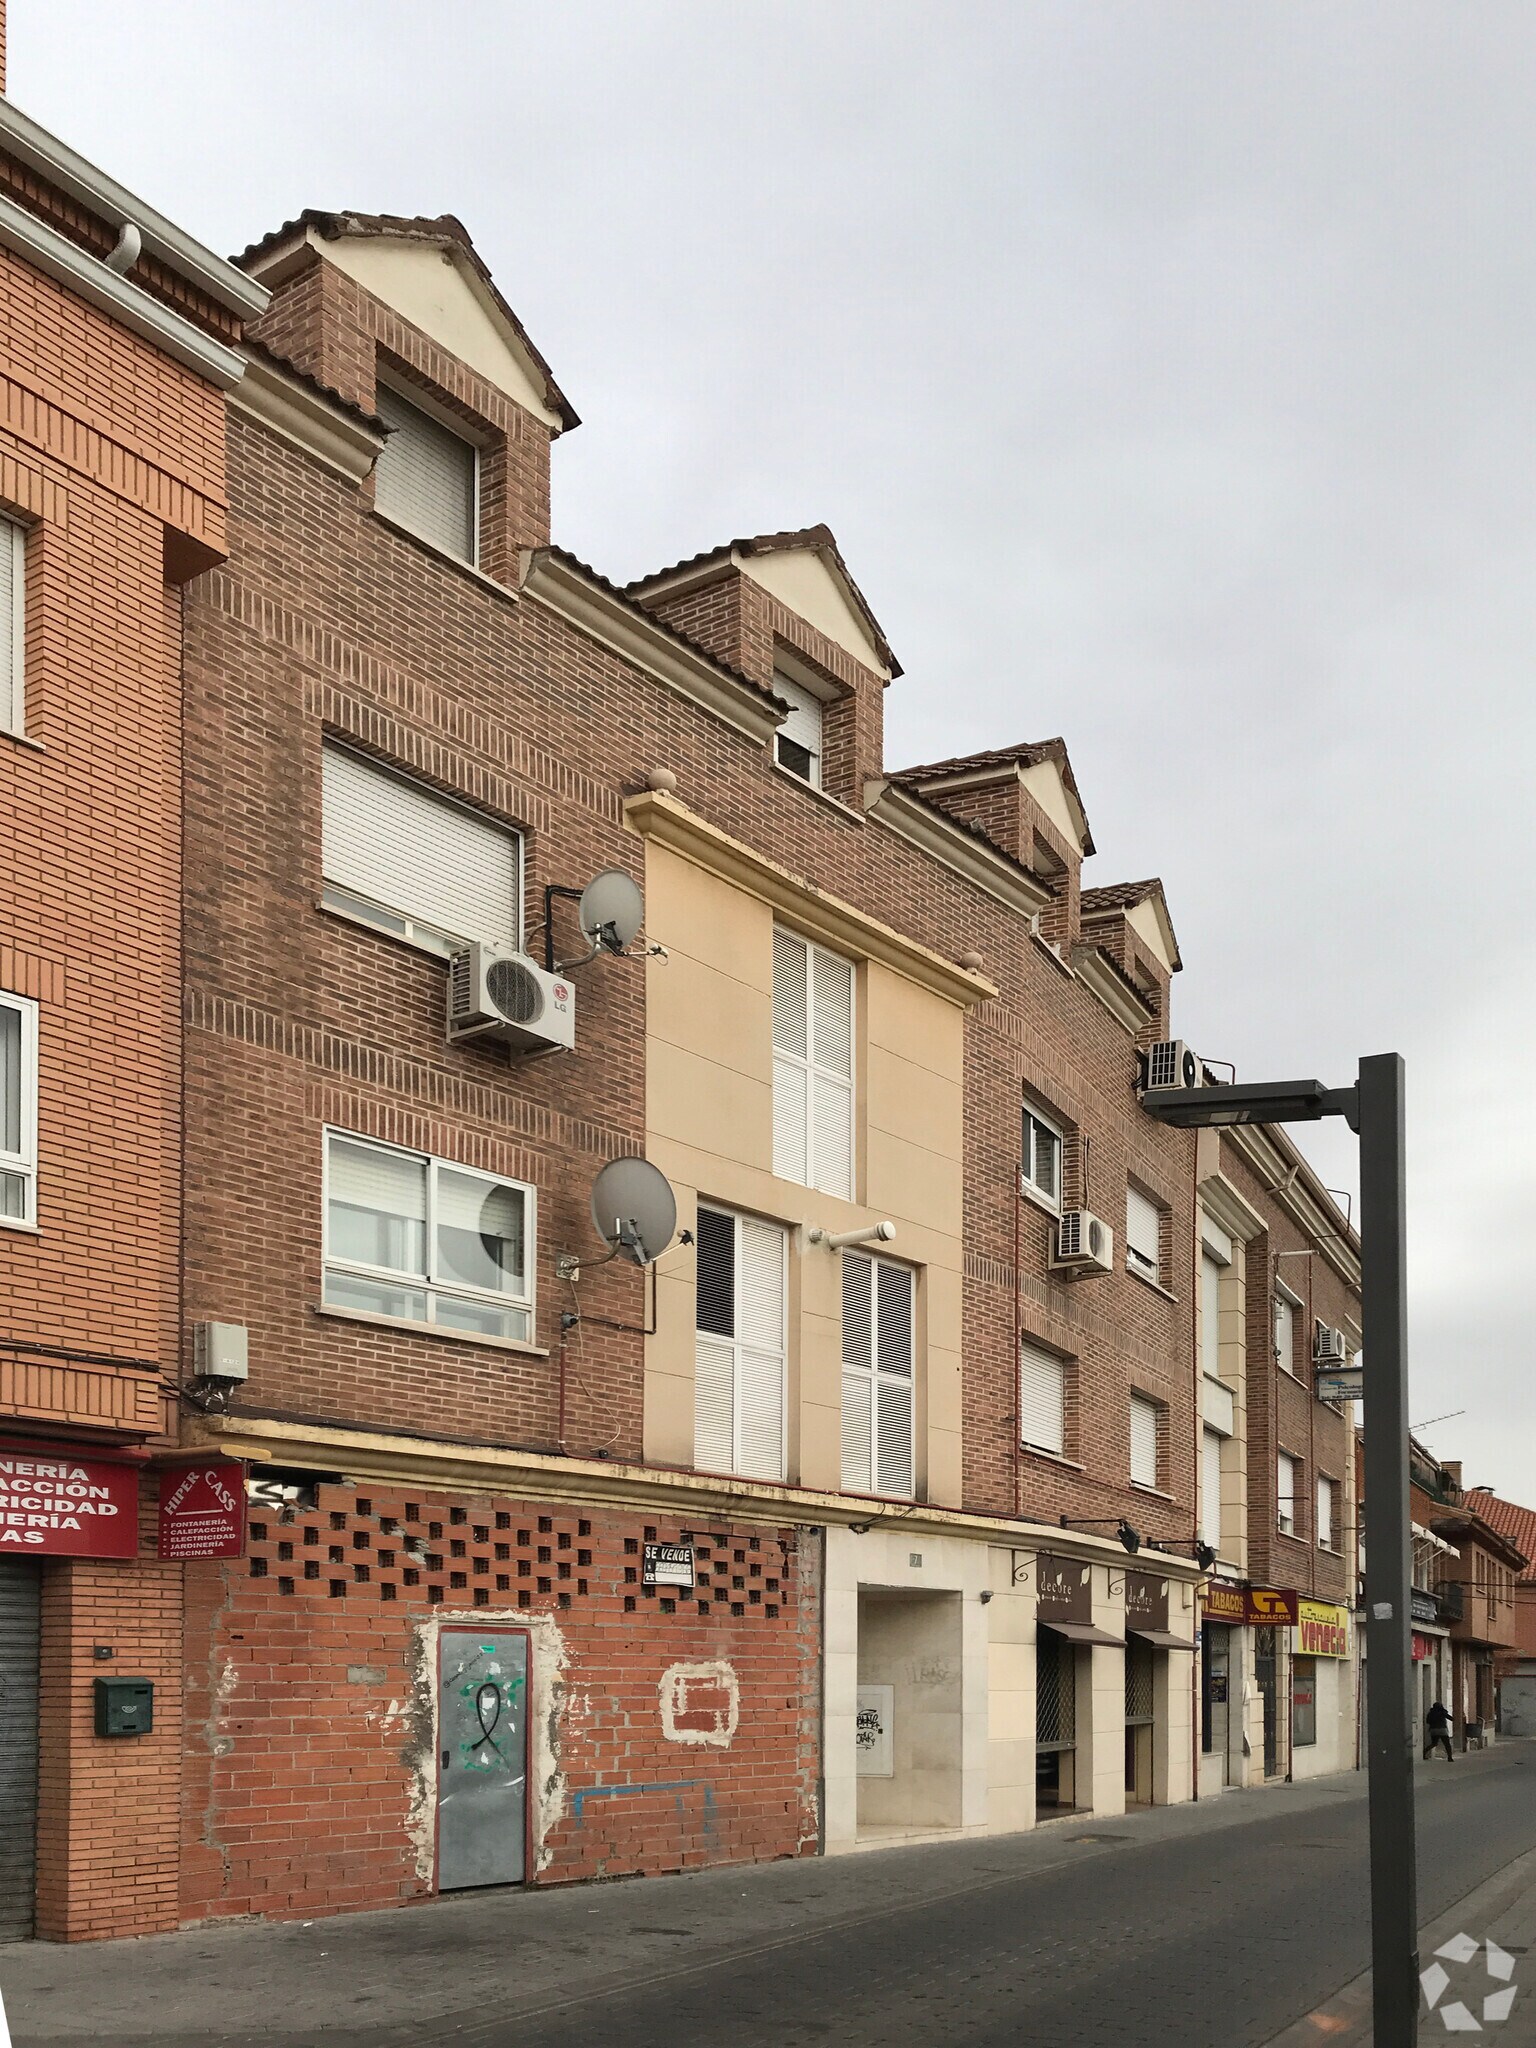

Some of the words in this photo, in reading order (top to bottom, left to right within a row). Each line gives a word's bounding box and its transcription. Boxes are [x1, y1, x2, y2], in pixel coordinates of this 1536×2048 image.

[554, 1001, 567, 1013] LG
[164, 1471, 200, 1516] HIPER
[205, 1470, 236, 1512] CASS
[0, 1512, 82, 1530] ERÍA
[170, 1518, 227, 1528] FONTANERÍA
[170, 1525, 233, 1536] CALEFACCIÓN
[170, 1533, 236, 1543] ELECTRICIDAD
[170, 1540, 225, 1550] JARDINERÍA
[170, 1549, 214, 1557] PISCINAS
[645, 1546, 658, 1559] SE
[661, 1548, 690, 1562] VENDE
[1210, 1590, 1244, 1613] TABACOS
